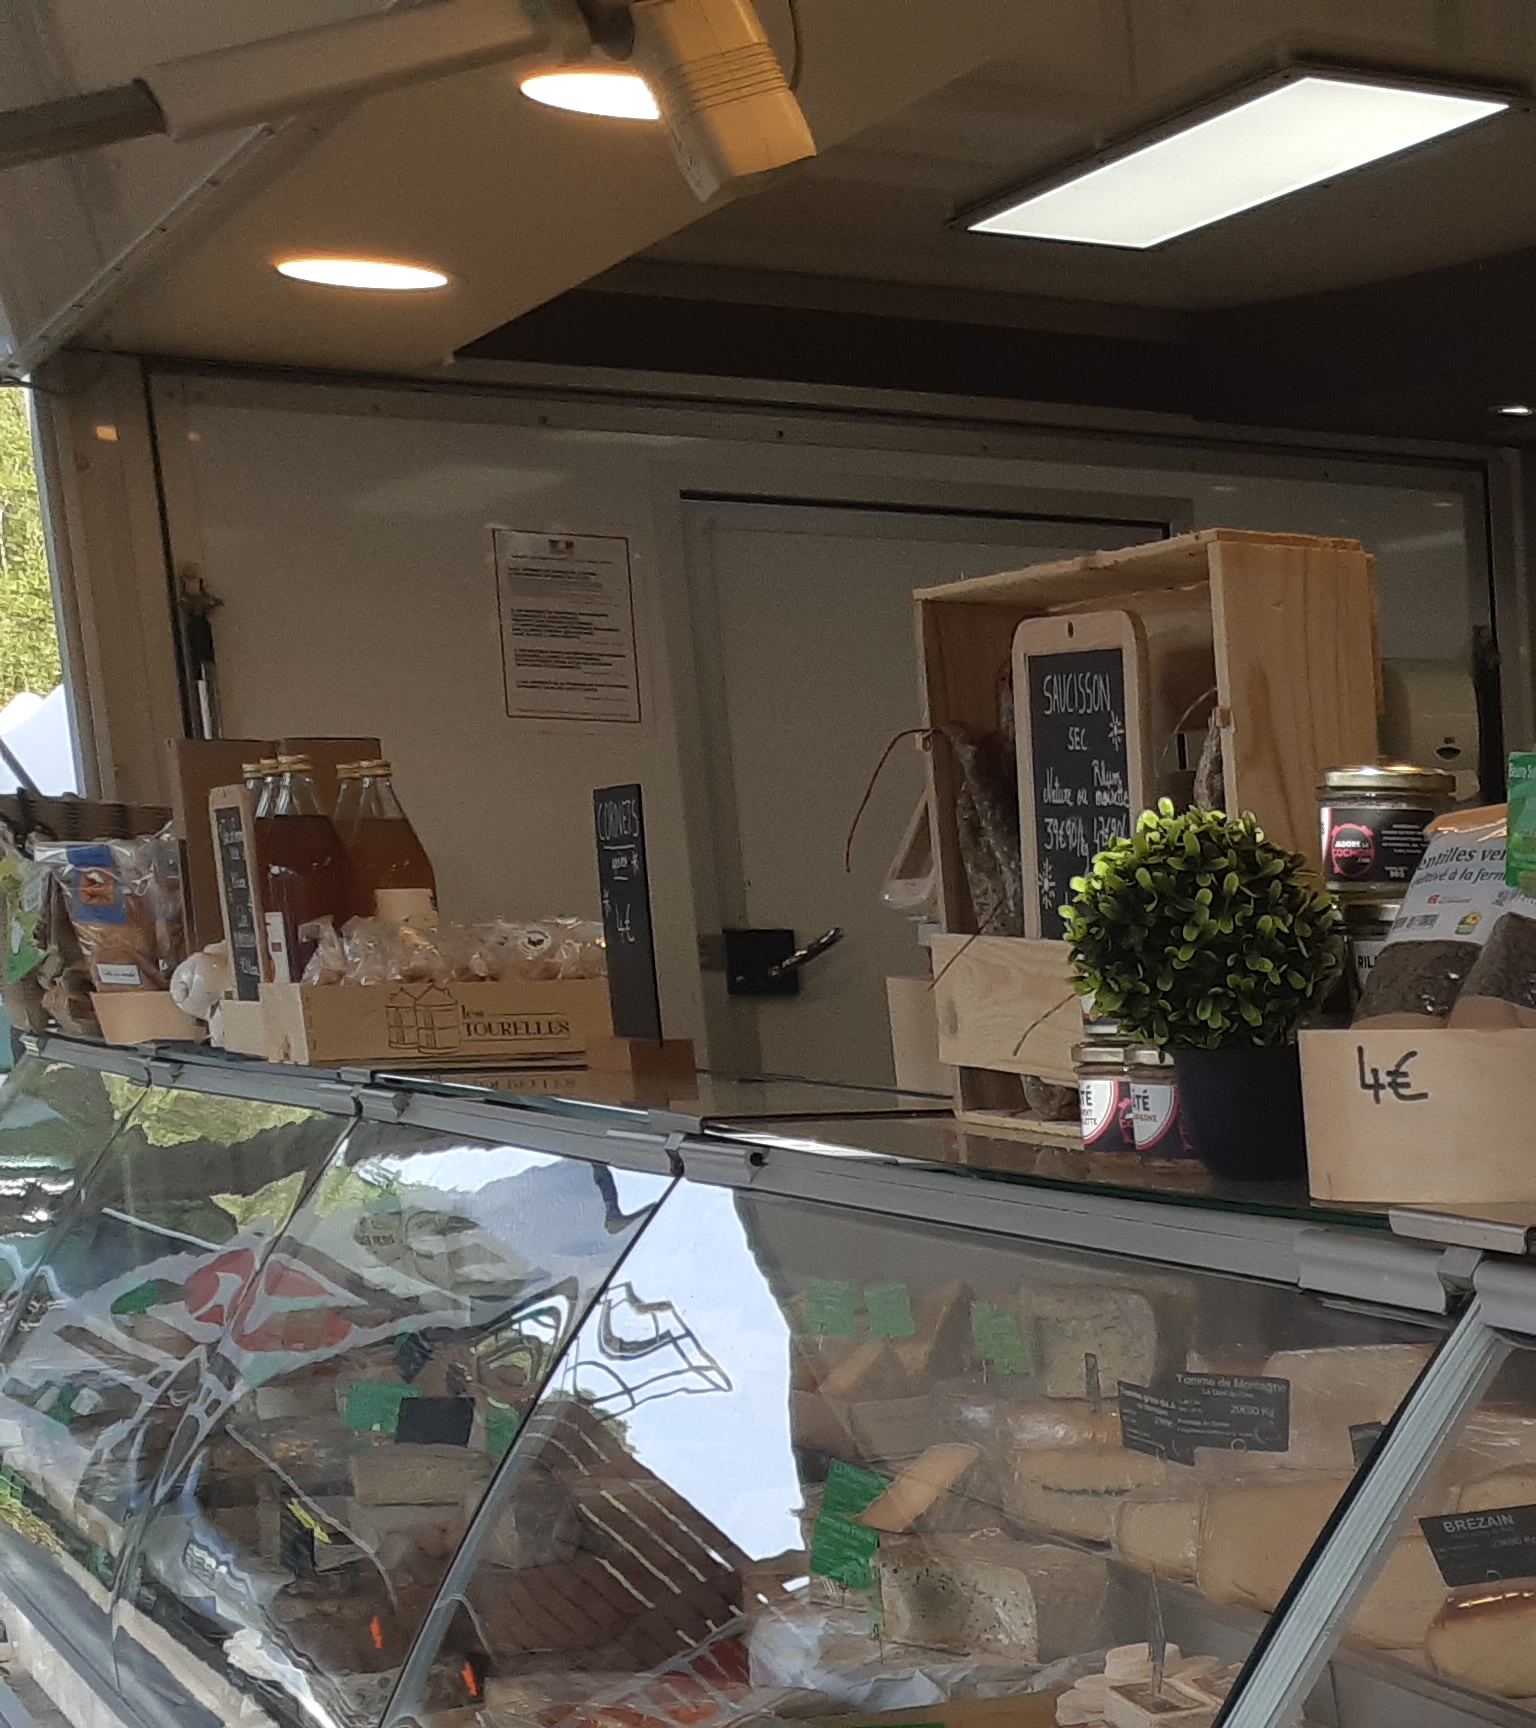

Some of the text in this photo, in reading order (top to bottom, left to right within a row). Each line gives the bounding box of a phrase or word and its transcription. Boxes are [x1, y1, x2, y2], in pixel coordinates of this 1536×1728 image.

[1043, 672, 1111, 715] SAUCISSON
[1067, 726, 1088, 751] SEC
[464, 1022, 570, 1036] TOURELLES
[1357, 1046, 1428, 1104] 4€
